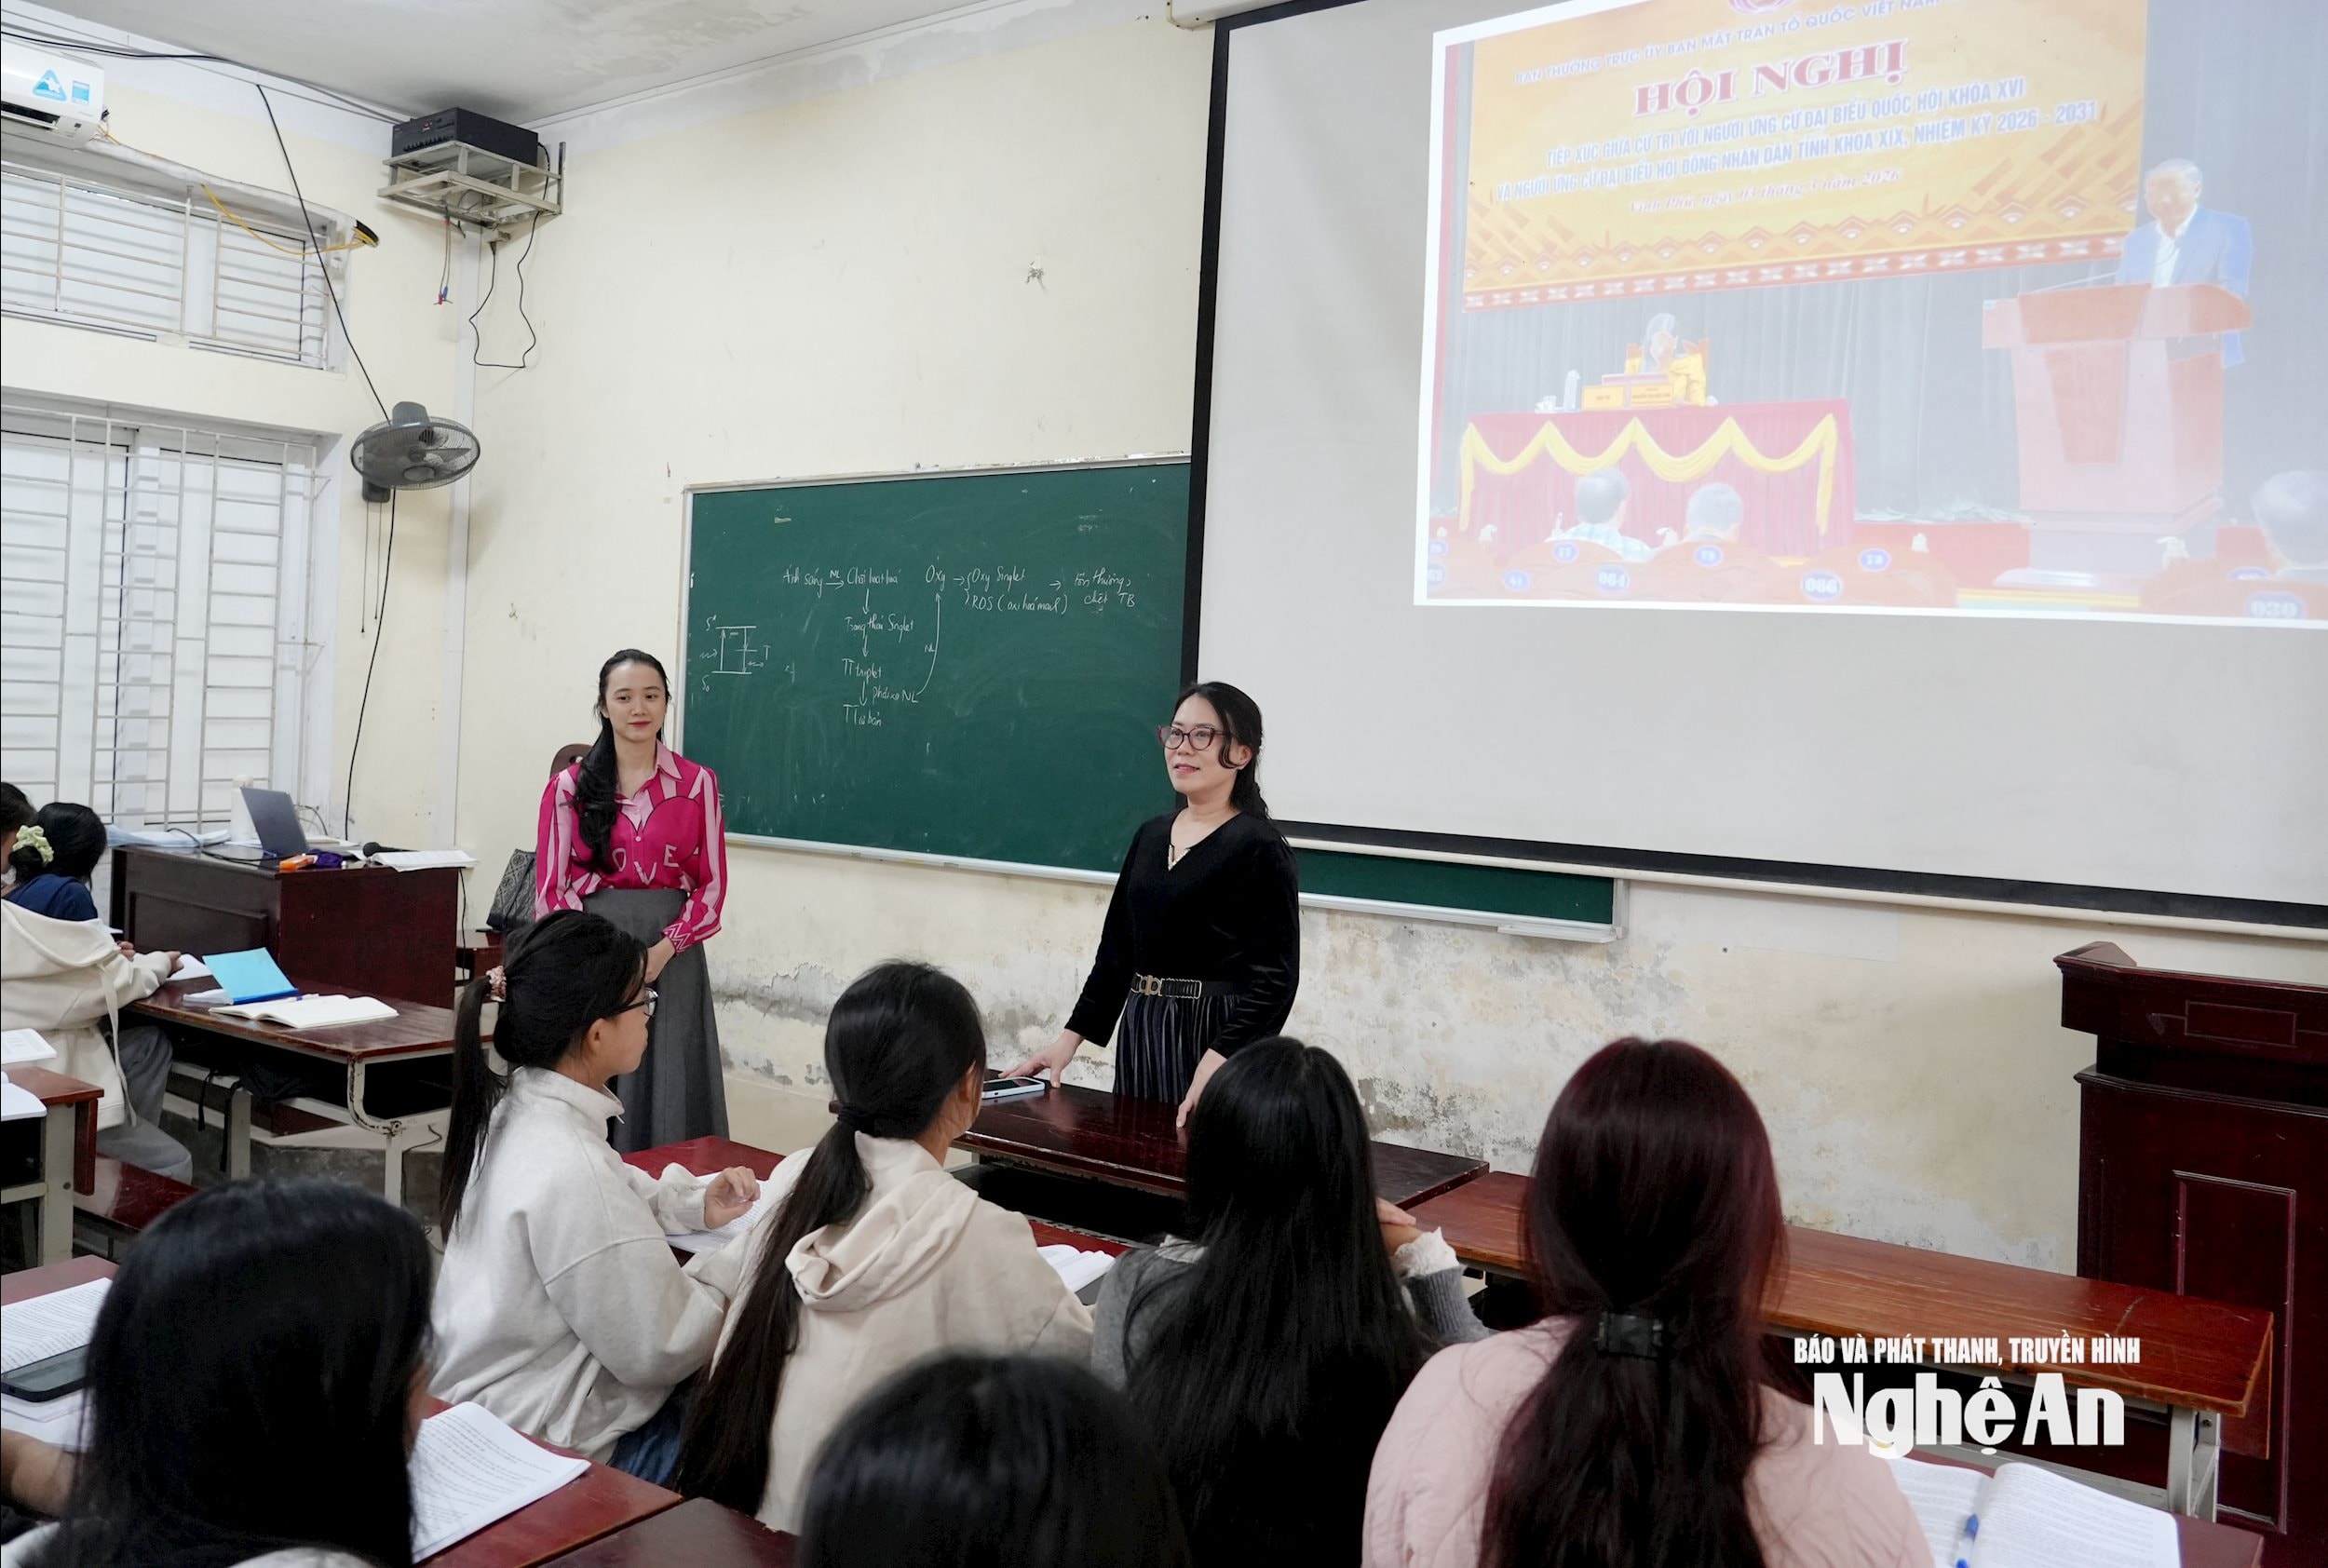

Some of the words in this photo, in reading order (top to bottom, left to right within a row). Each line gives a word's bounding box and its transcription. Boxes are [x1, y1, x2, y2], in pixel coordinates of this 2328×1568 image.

[1515, 70, 1541, 84] BAN
[1667, 40, 1696, 55] BAN
[1805, 7, 1856, 28] QUỐC
[1634, 68, 1738, 117] HỘI
[1753, 39, 1908, 95] NGHỊ
[1657, 132, 1674, 150] TRI
[1805, 108, 1829, 131] ĐẠI
[1872, 91, 1912, 120] QUỐC
[1917, 88, 1942, 115] HỘI
[1948, 80, 1992, 107] KHÓA
[1997, 77, 2026, 99] XVI
[1914, 117, 1966, 145] NHIỆM
[1996, 108, 2037, 133] 2026
[2055, 101, 2097, 125] 2031
[612, 843, 679, 885] OVE
